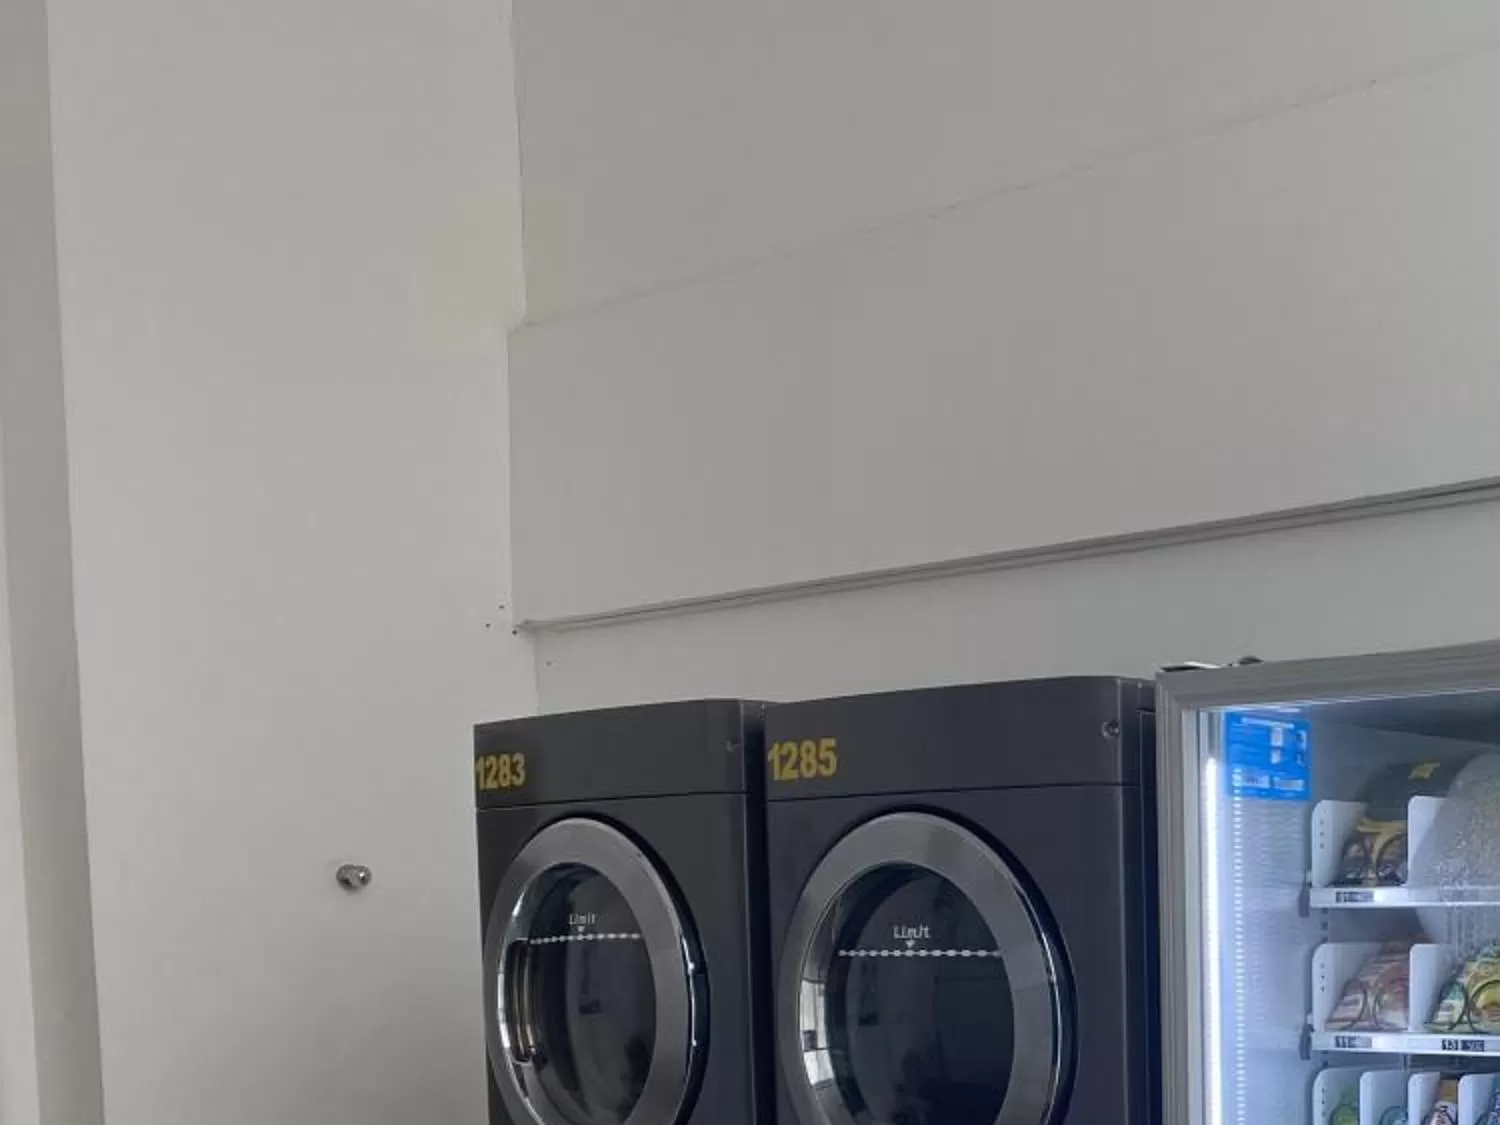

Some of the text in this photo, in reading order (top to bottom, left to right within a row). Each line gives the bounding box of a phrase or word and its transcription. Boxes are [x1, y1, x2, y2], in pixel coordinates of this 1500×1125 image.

[476, 753, 526, 790] 1283
[768, 739, 837, 780] 1285
[569, 911, 596, 925] Limit
[893, 924, 931, 939] Limit
